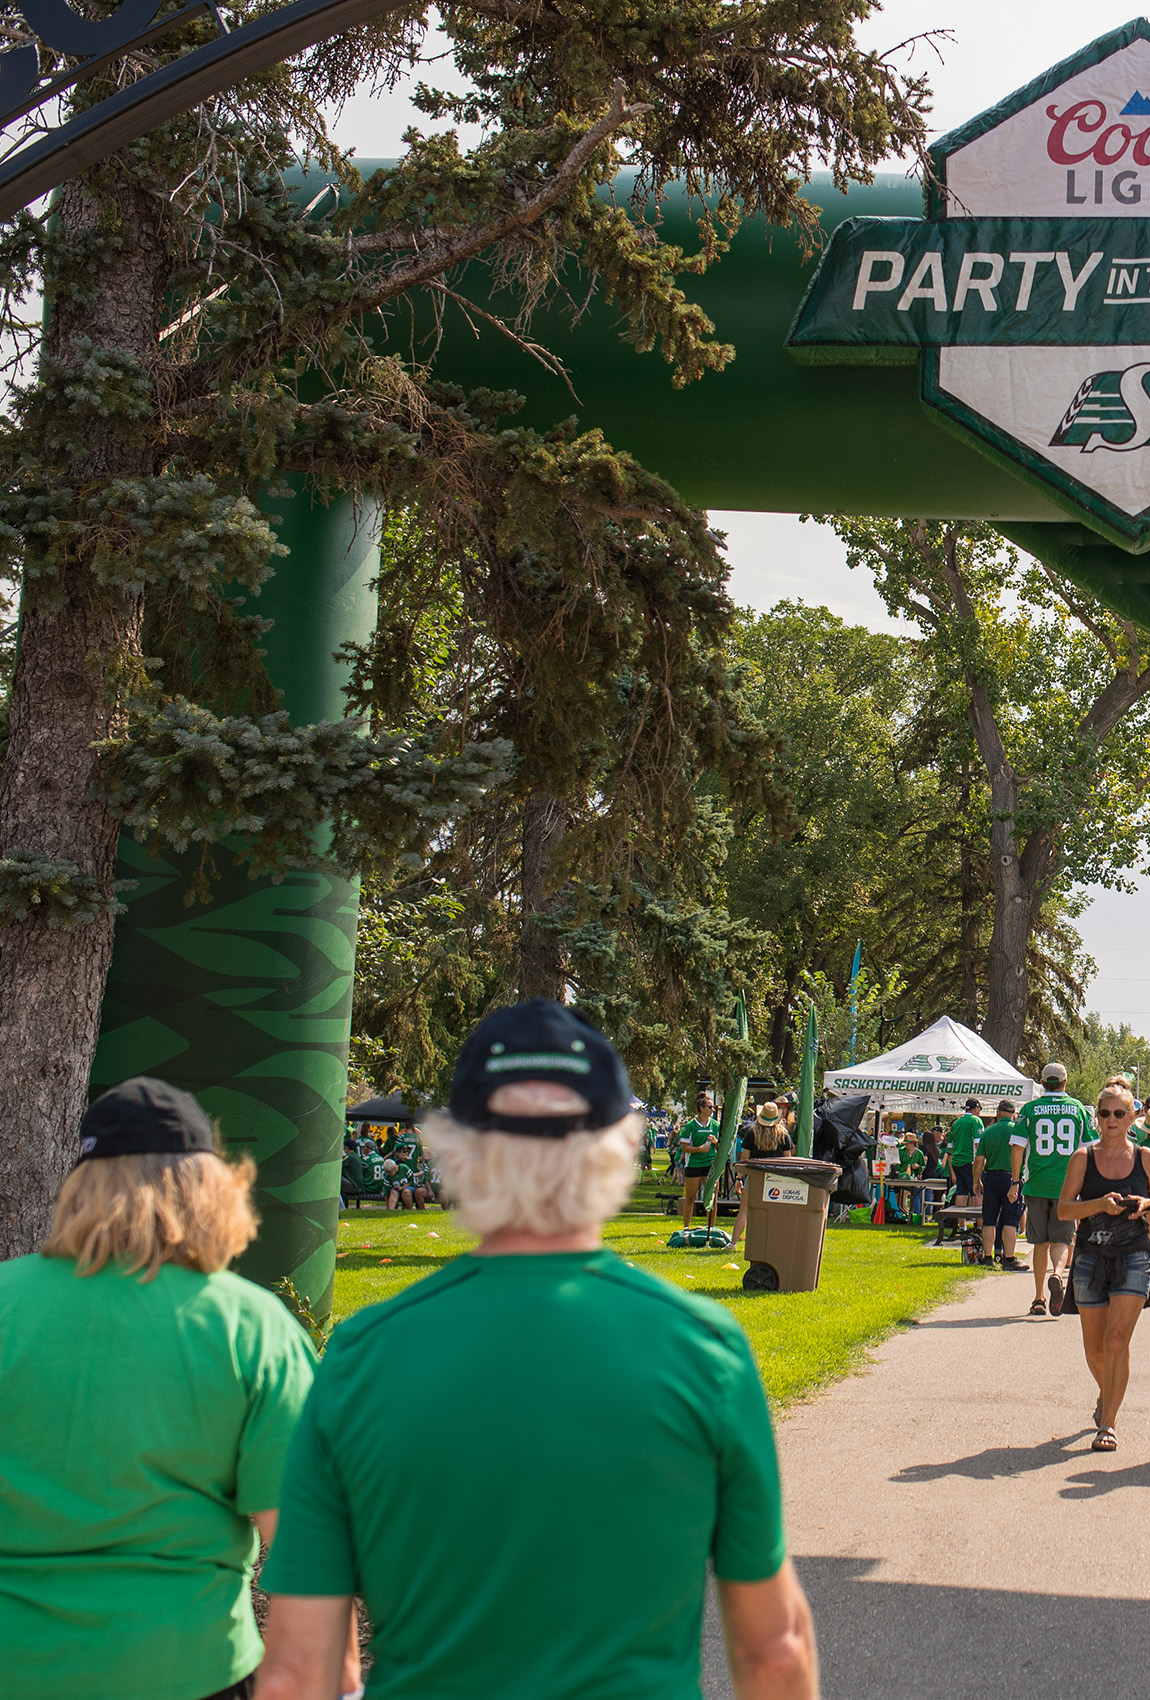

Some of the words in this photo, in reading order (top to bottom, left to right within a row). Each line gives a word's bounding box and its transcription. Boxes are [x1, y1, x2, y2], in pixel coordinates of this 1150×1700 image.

[852, 251, 1104, 312] PARTY
[1107, 267, 1140, 295] IN
[833, 1078, 935, 1092] SASKATCHEWAN
[936, 1081, 1024, 1096] ROUGHRIDERS
[1034, 1104, 1078, 1116] SCHAFFER-BAKER
[1036, 1118, 1075, 1156] 89
